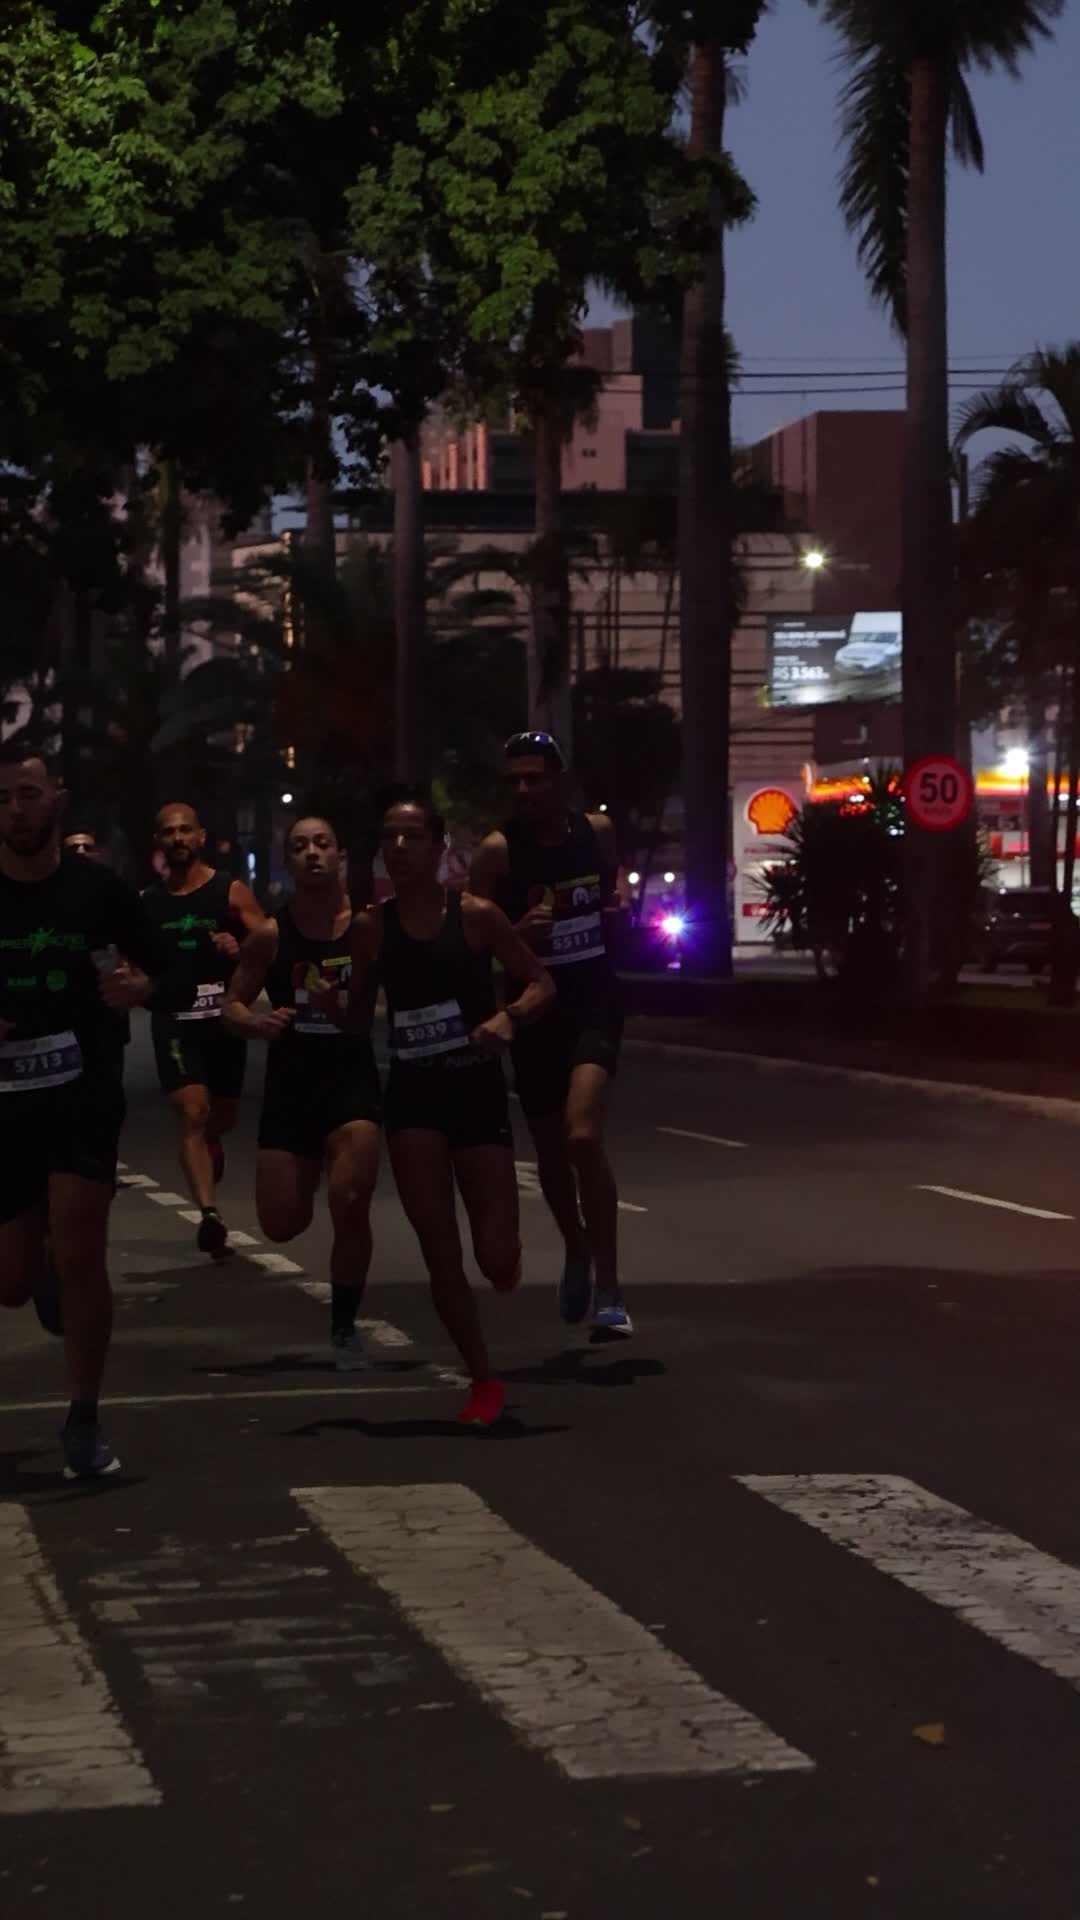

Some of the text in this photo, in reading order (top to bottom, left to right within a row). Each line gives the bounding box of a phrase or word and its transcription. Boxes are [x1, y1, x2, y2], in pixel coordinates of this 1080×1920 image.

[920, 772, 958, 804] 50
[552, 931, 589, 949] 5511
[405, 1022, 447, 1042] 5039
[13, 1052, 63, 1073] 5713
